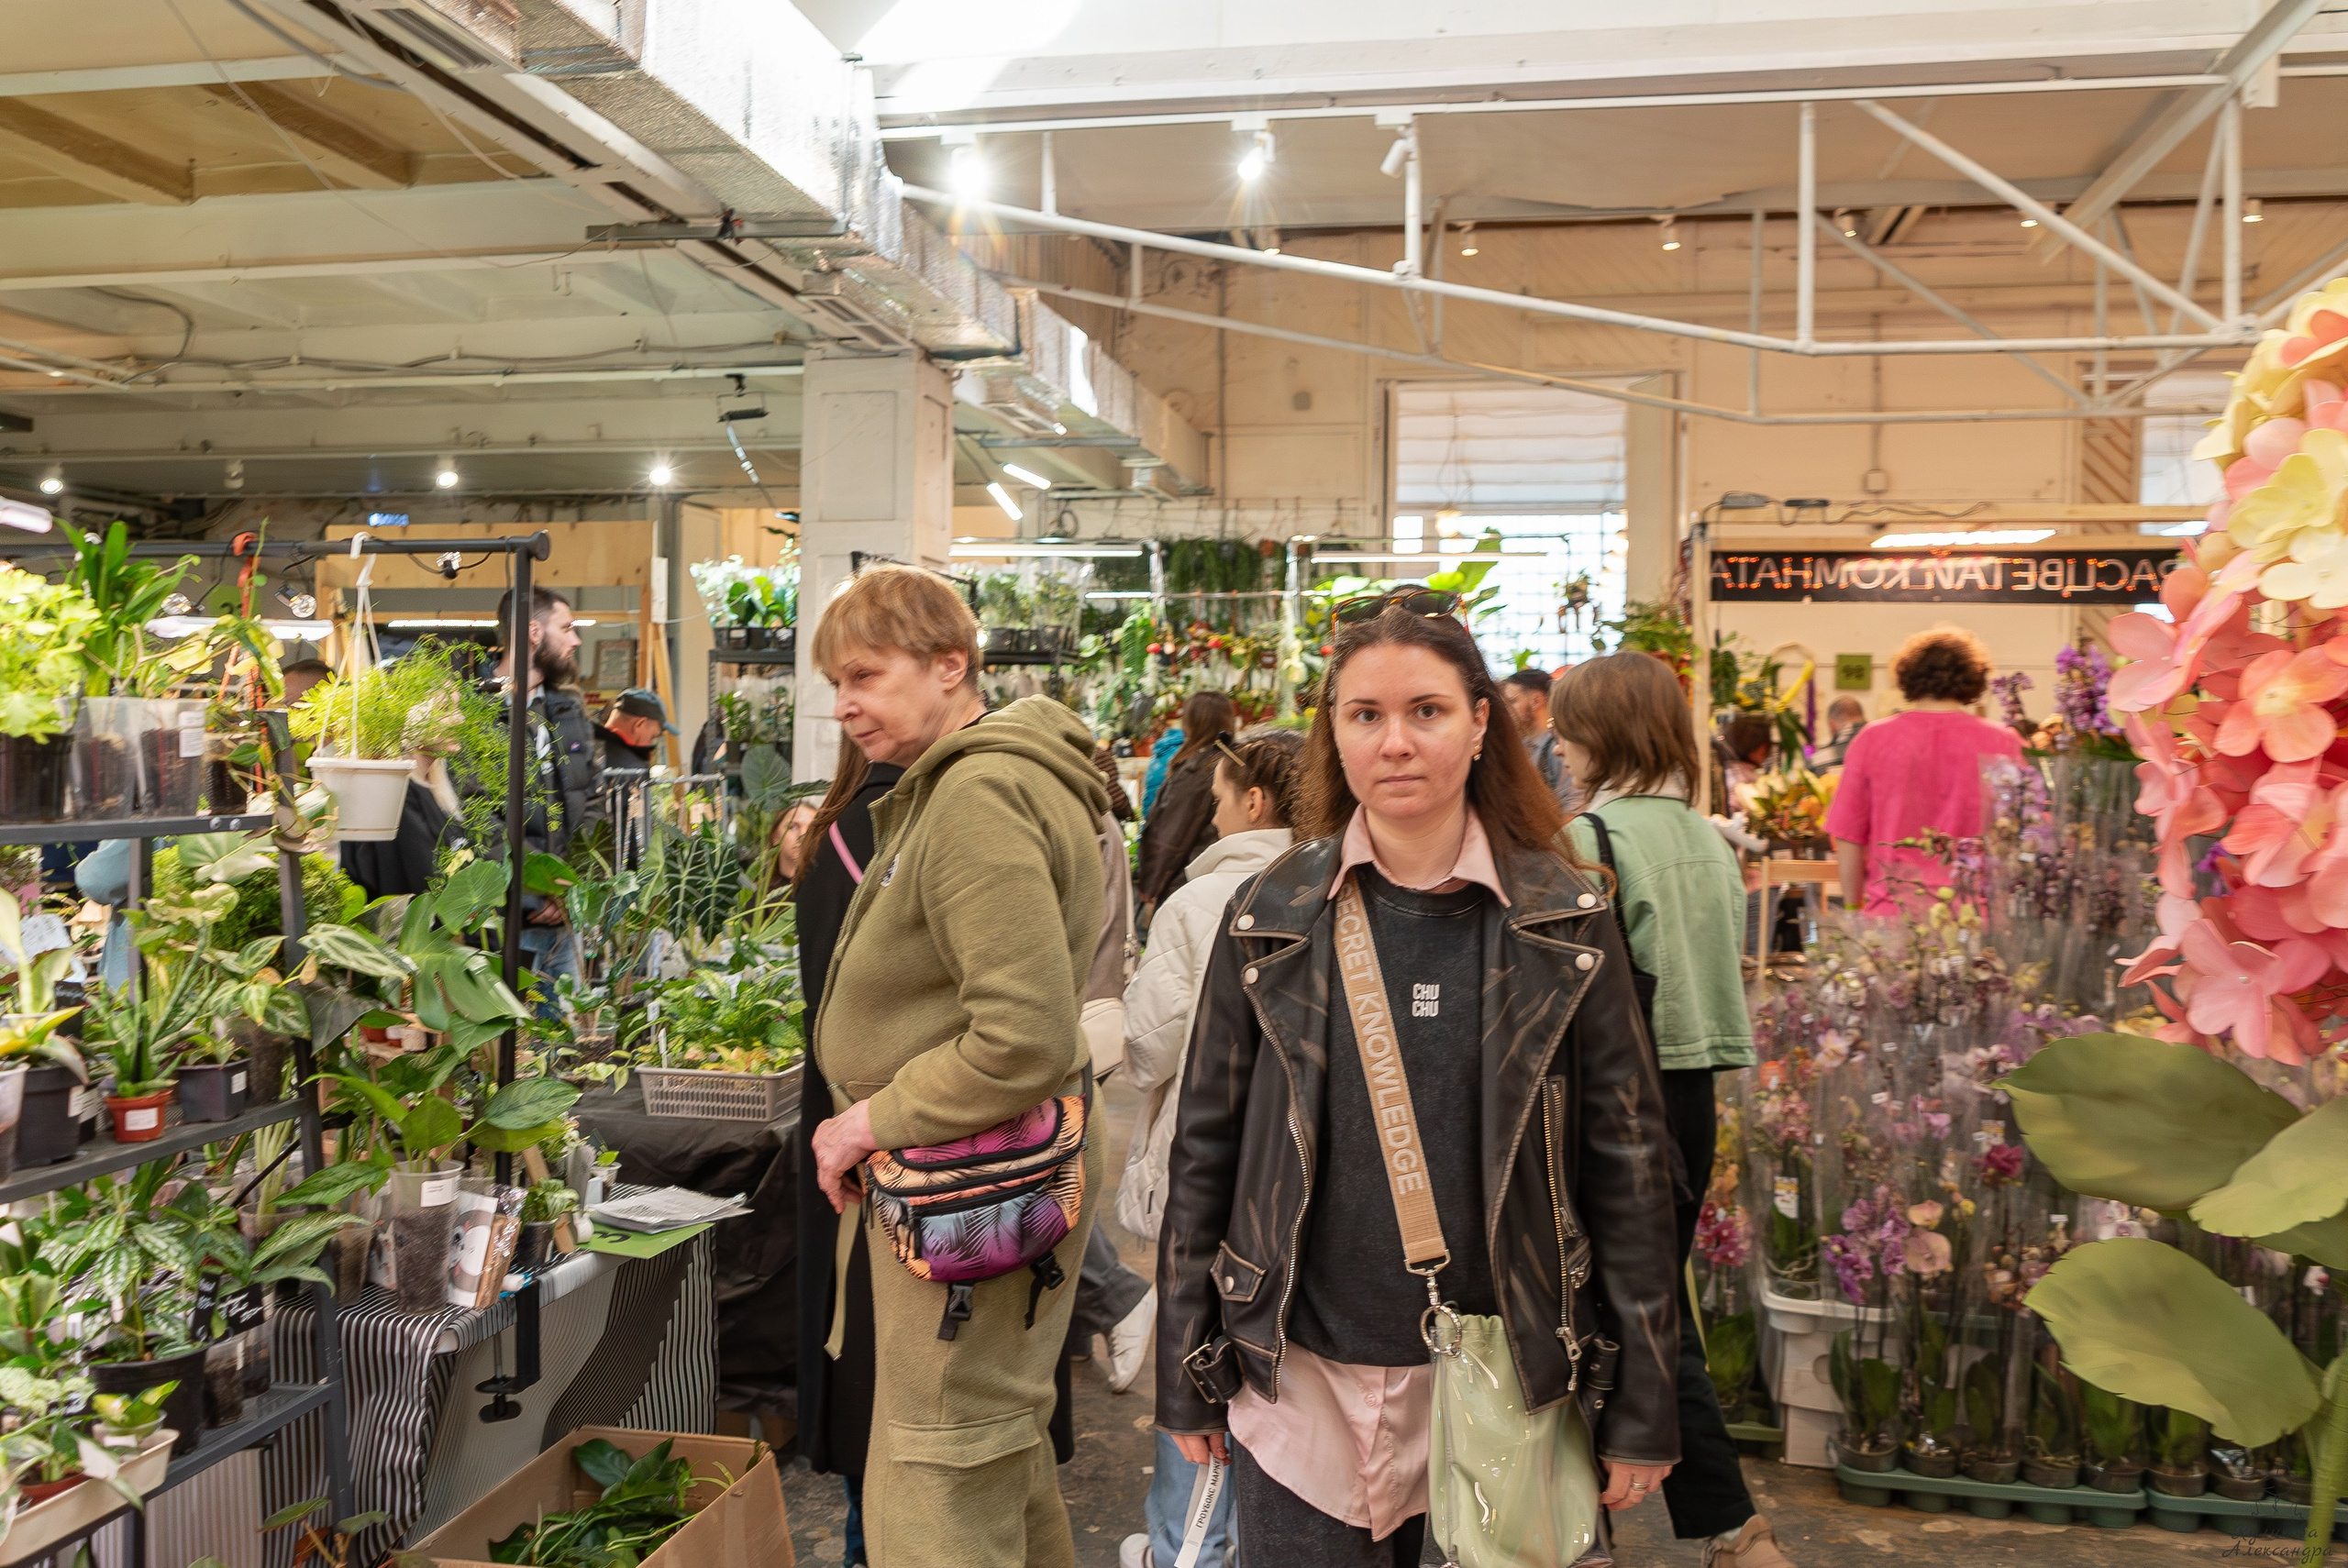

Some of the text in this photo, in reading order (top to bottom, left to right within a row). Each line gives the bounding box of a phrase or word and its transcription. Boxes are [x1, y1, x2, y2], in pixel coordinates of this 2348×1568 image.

[1412, 982, 1440, 1000] CHU
[1412, 999, 1439, 1018] CHU
[1336, 883, 1423, 1196] SECRET KNOWLEDGE
[1196, 1487, 1215, 1529] ГРОУБОКС
